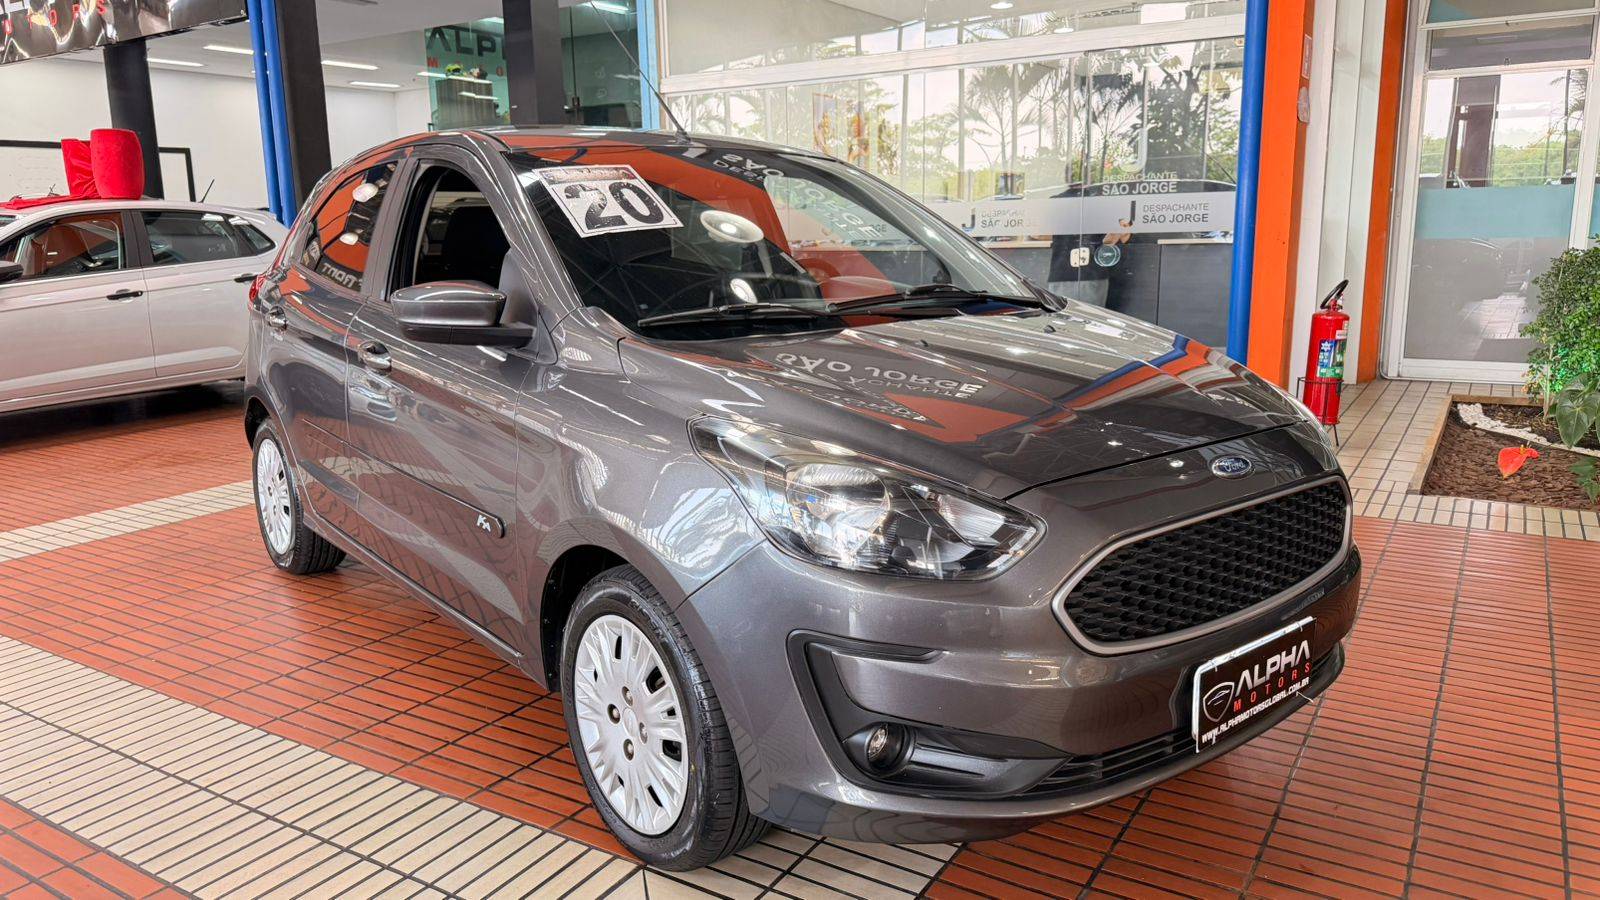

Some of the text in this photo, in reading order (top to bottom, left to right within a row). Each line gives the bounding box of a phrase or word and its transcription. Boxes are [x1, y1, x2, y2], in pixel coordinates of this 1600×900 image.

[1132, 181, 1178, 194] JORGE
[564, 181, 664, 231] 20
[1142, 203, 1209, 213] DESPACHANTE
[1142, 211, 1209, 224] SÃO JORGE
[1235, 640, 1310, 697] ALPHA
[1233, 662, 1310, 712] MOTORS
